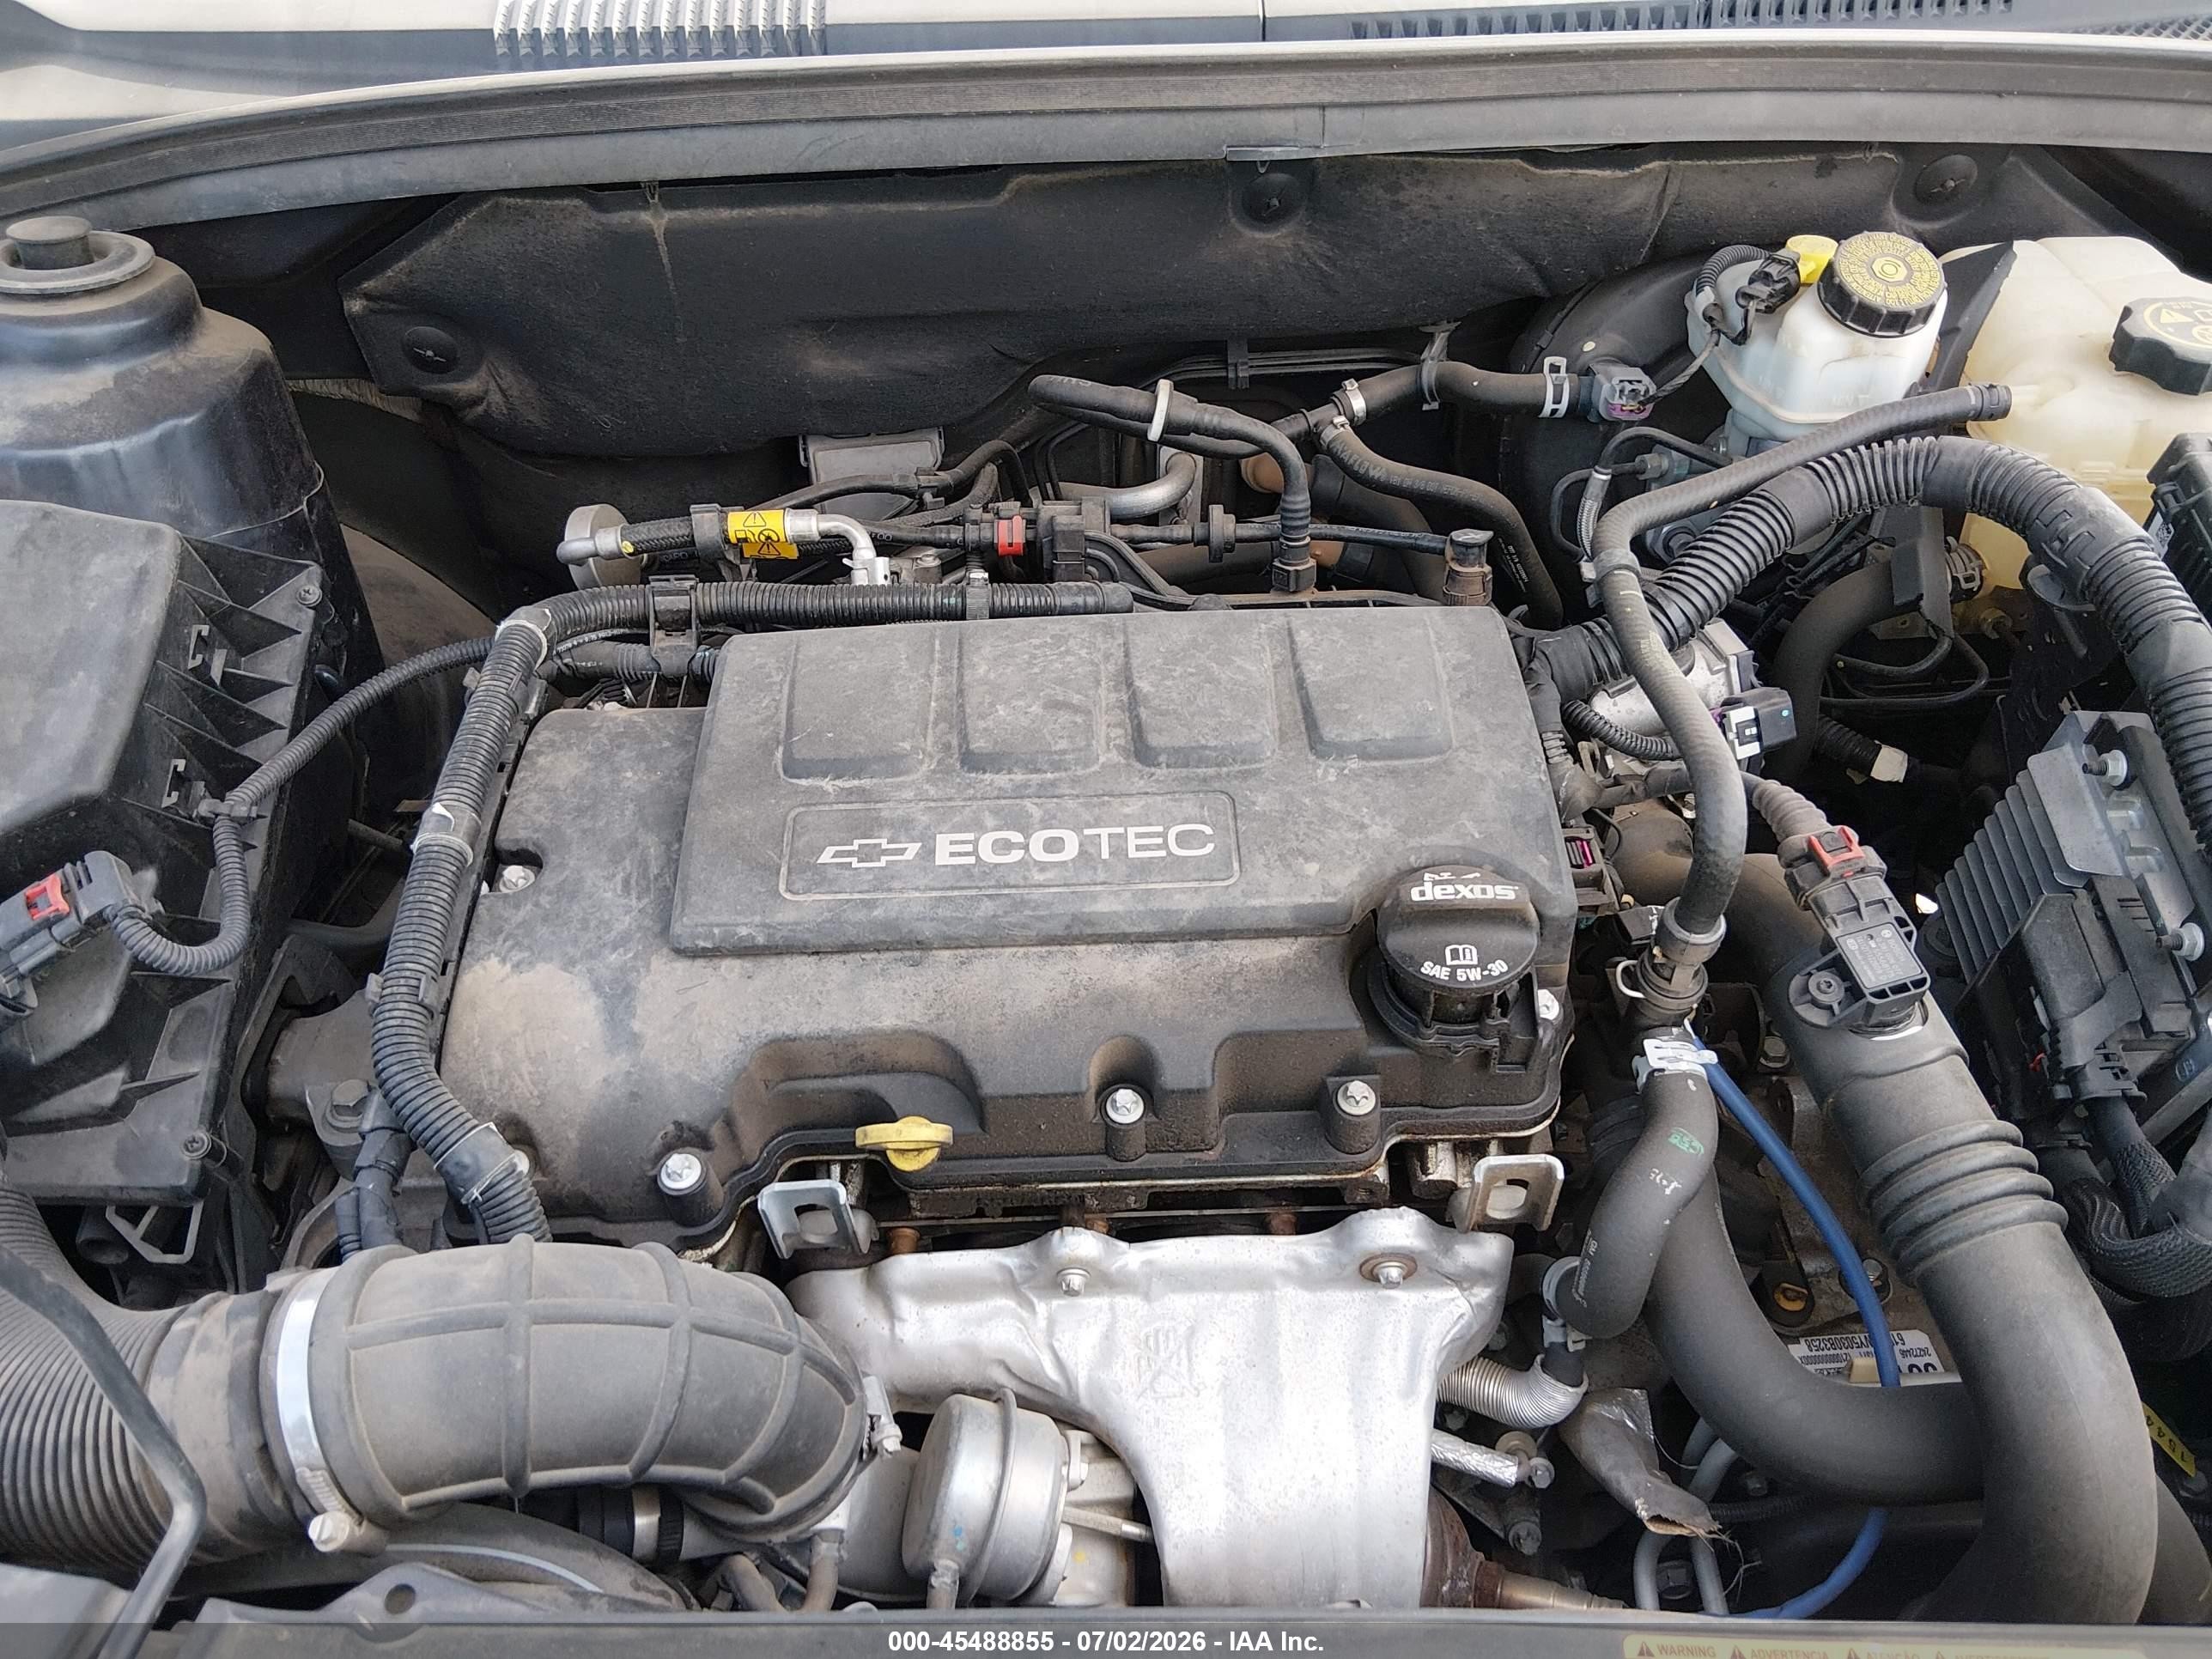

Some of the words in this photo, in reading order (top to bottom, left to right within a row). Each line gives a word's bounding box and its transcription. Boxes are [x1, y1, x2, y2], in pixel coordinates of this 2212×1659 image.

[935, 823, 1215, 866] ECOTEC
[1411, 881, 1515, 902] dexos
[1420, 961, 1451, 980] SAE
[1456, 959, 1509, 981] 5W-30
[1656, 1644, 1716, 1657] WARNING
